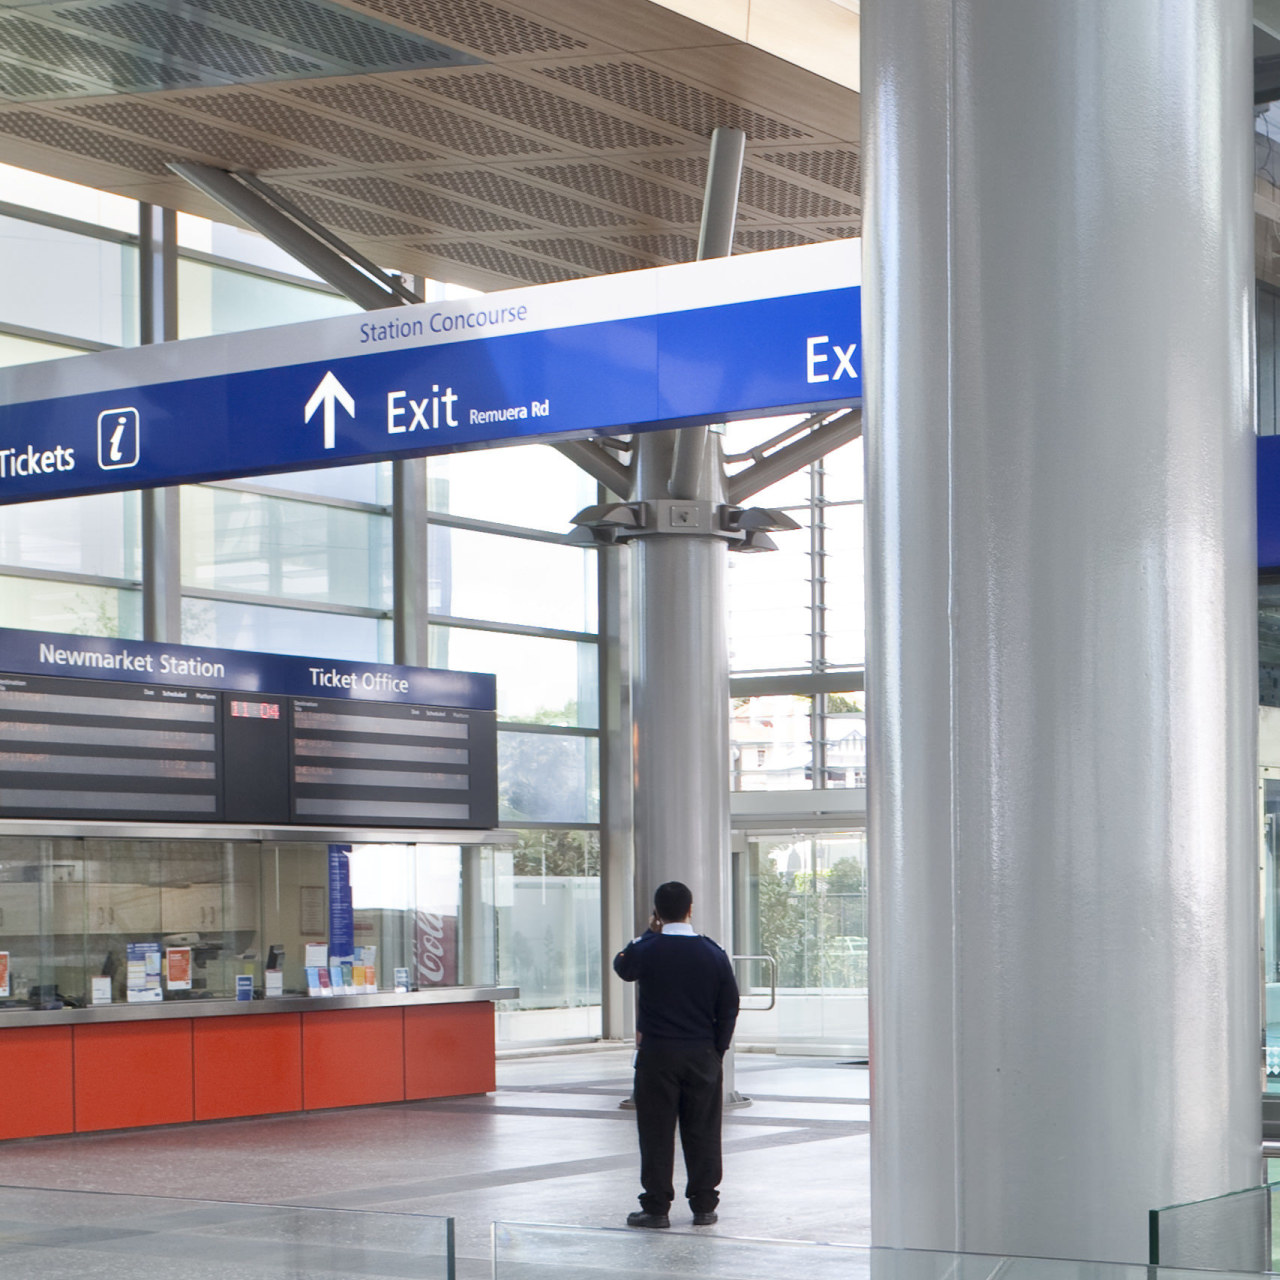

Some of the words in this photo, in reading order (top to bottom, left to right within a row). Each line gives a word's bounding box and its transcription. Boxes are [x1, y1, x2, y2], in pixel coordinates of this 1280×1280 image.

[360, 318, 423, 344] Station
[429, 305, 528, 333] Concourse
[806, 334, 859, 384] Ex
[387, 385, 459, 434] Exit
[469, 407, 528, 425] Remuera
[531, 399, 550, 418] Rd
[0, 444, 76, 478] Tickets
[39, 642, 154, 674] Newmarket
[160, 653, 225, 679] Station
[309, 666, 359, 690] Ticket
[361, 671, 409, 694] Office
